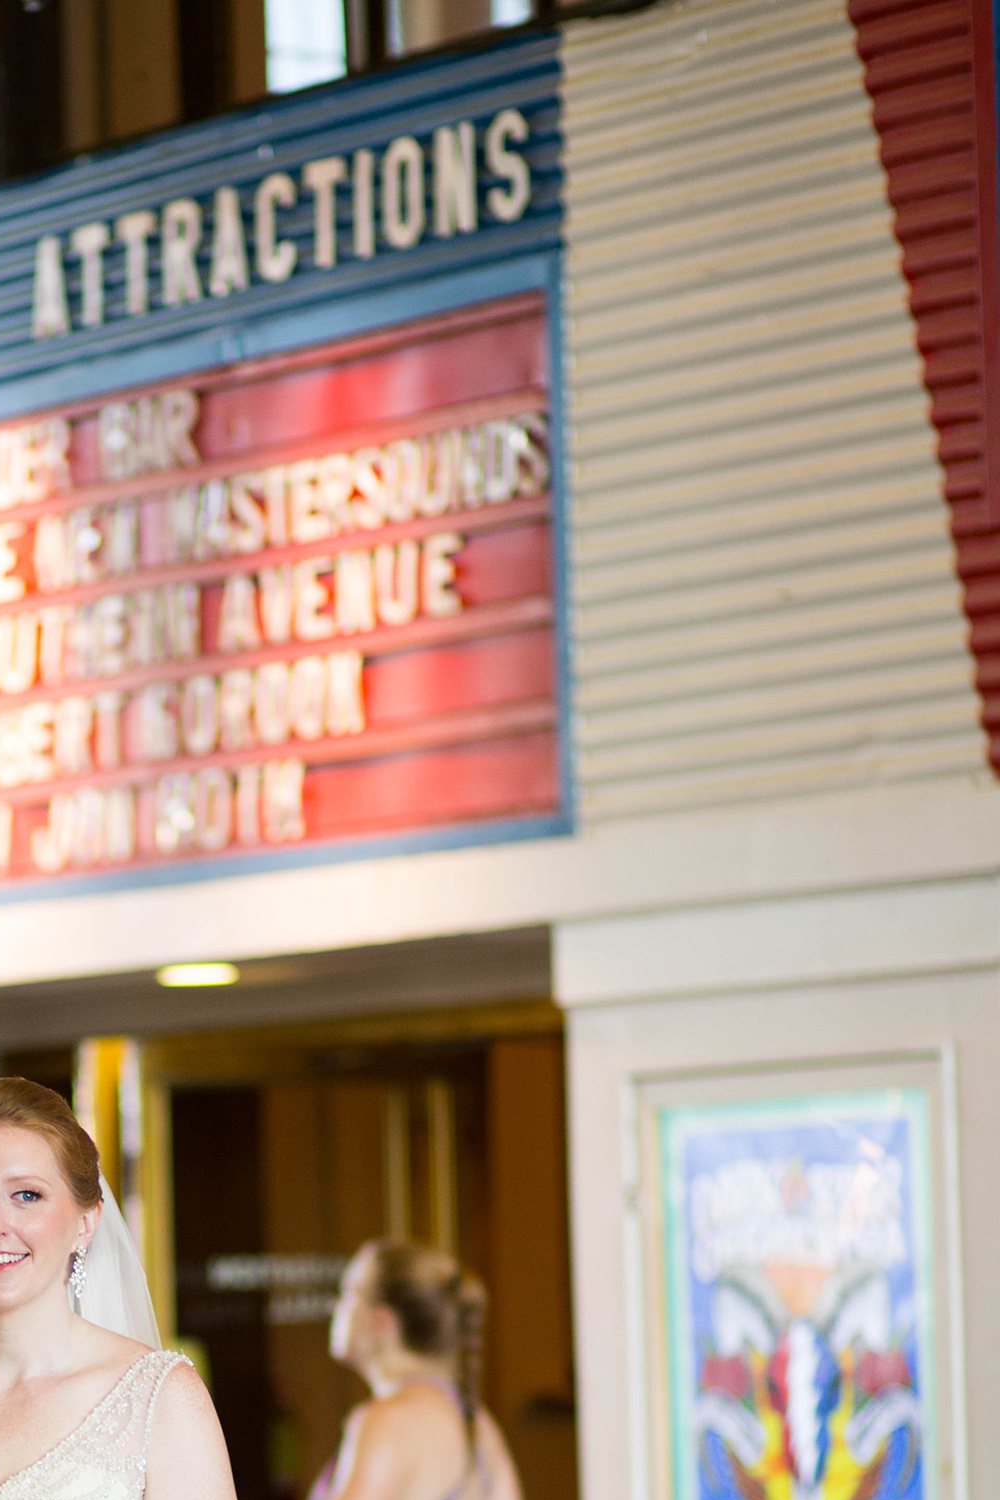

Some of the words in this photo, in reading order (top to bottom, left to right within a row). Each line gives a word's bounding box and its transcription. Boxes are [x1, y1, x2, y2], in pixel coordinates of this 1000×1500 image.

[31, 107, 534, 340] ATTRACTIONS
[163, 412, 548, 564] MASTERSOUNDS
[218, 534, 464, 651] AVENUE
